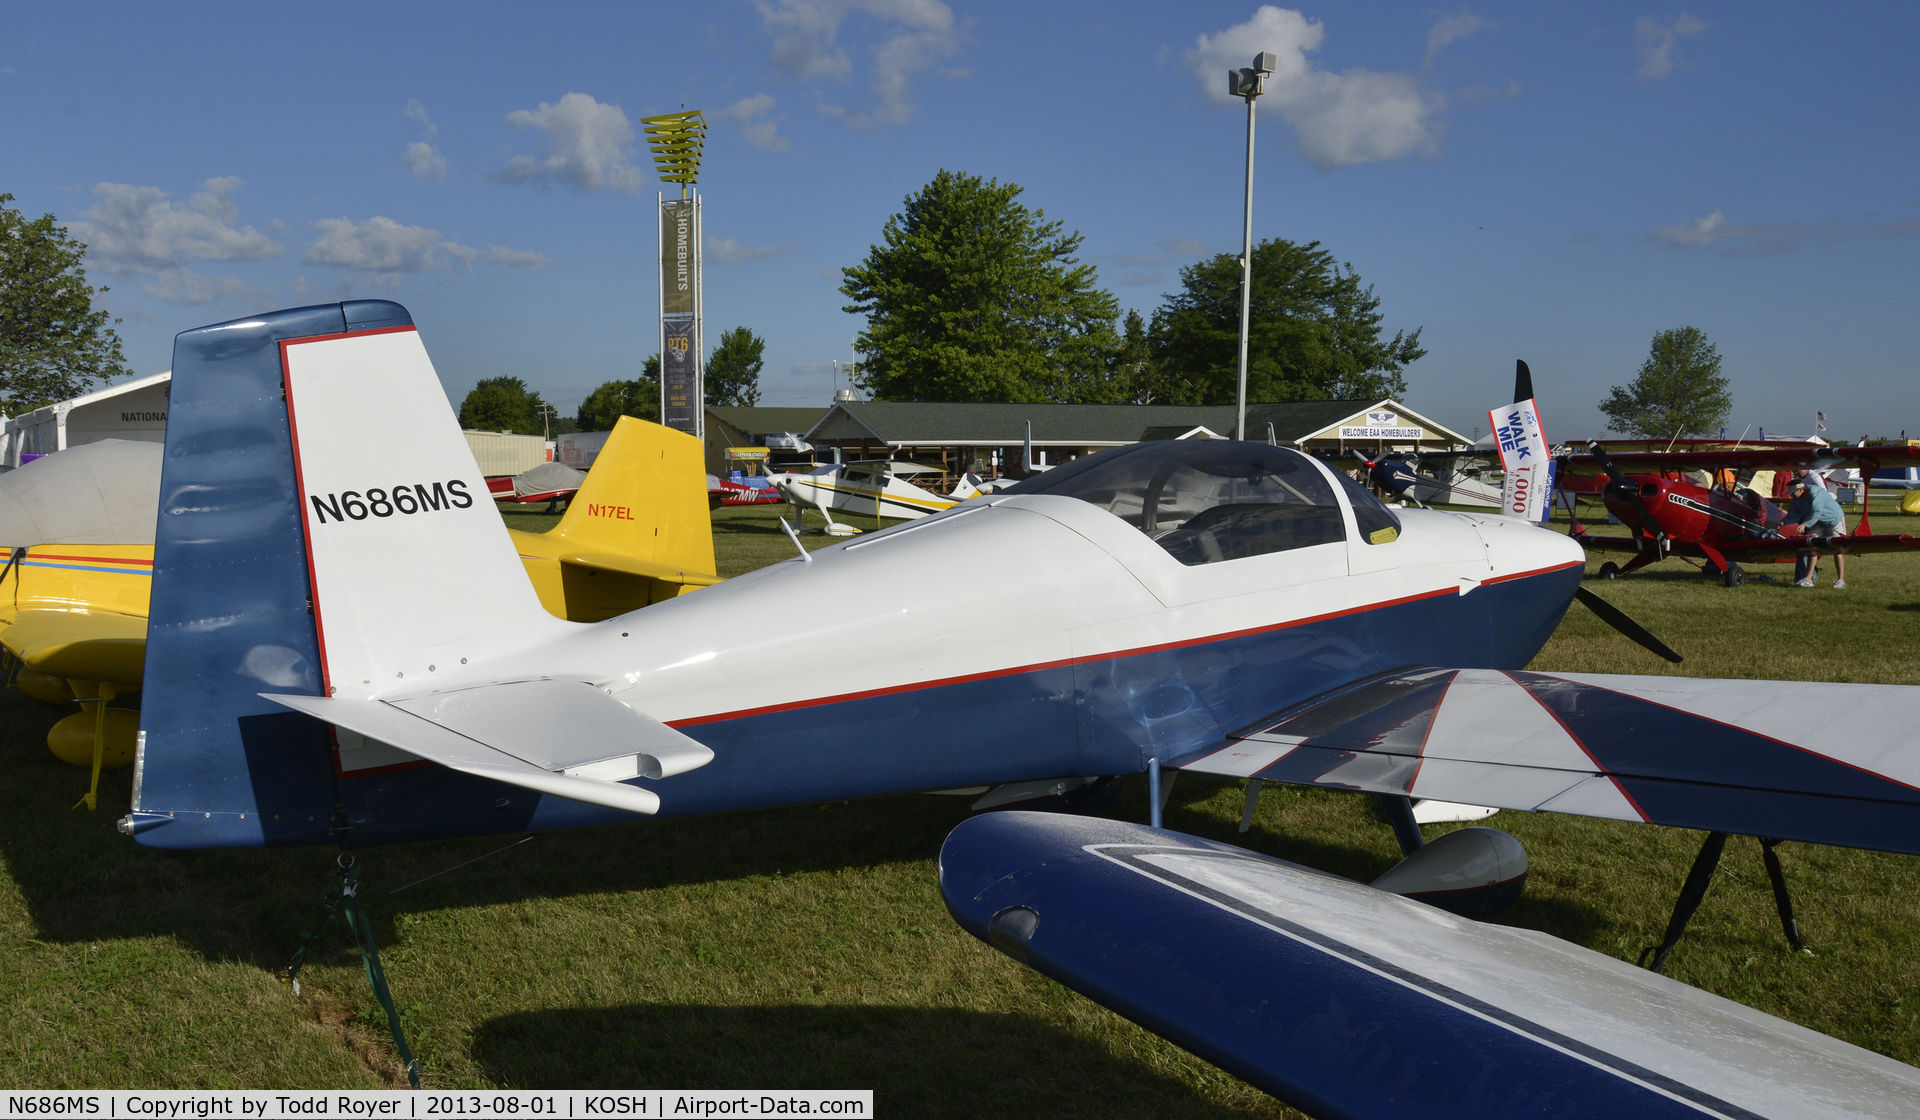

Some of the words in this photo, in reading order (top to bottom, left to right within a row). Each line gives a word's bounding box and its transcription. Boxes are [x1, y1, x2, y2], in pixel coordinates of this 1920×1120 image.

[677, 218, 688, 291] HOMEBUILTS
[667, 337, 689, 353] PT6
[121, 412, 167, 422] NATIONA
[1342, 428, 1368, 437] WELCOME
[1370, 428, 1380, 437] EAA
[1381, 429, 1421, 438] HOMEBUILDERS
[1497, 426, 1515, 453] ME
[1508, 411, 1532, 460] WALK
[310, 479, 473, 524] N686MS
[1506, 471, 1514, 504] HOURS
[1512, 466, 1530, 513] 1,000
[588, 503, 635, 521] N17EL
